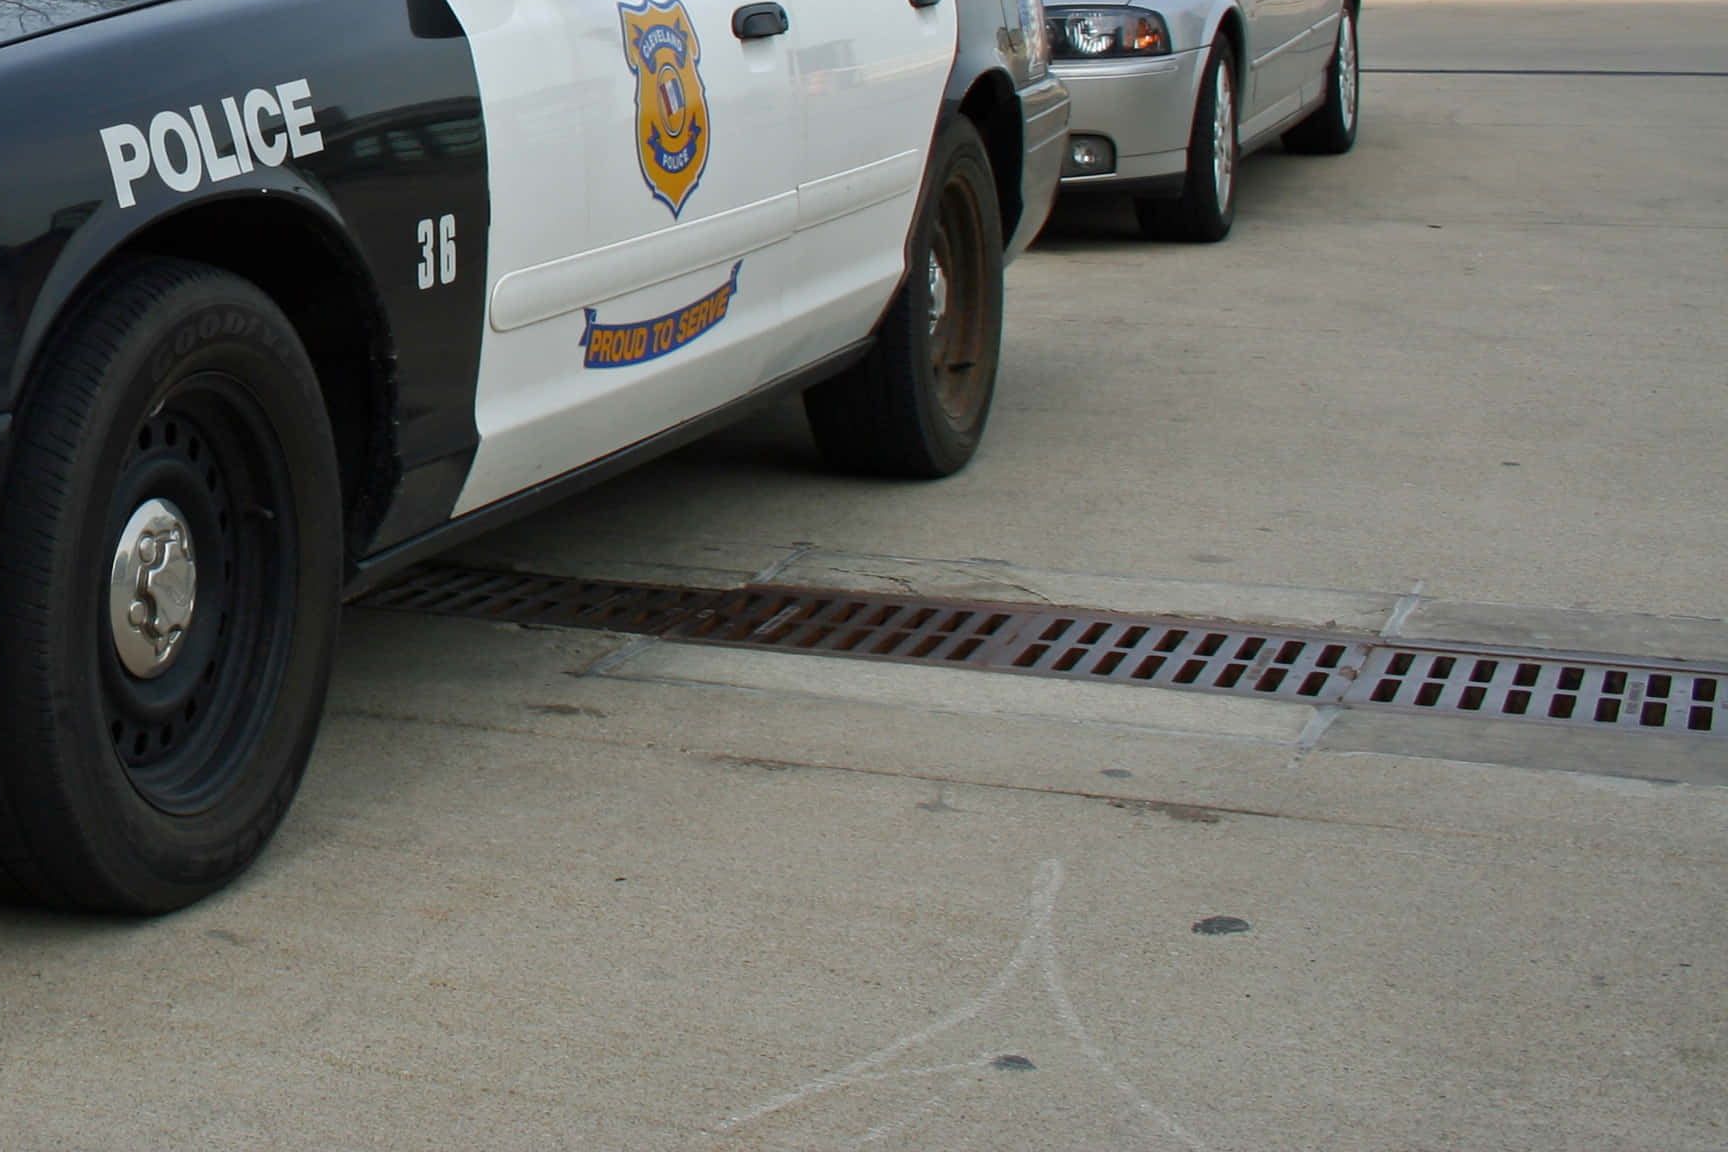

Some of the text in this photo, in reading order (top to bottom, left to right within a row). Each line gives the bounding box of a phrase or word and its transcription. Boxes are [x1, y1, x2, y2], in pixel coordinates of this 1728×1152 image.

[642, 29, 683, 58] CLEVELAND
[99, 78, 324, 209] POLICE
[662, 148, 690, 170] POLICE
[416, 212, 457, 290] 36
[588, 285, 732, 362] PROUD TO SERVE
